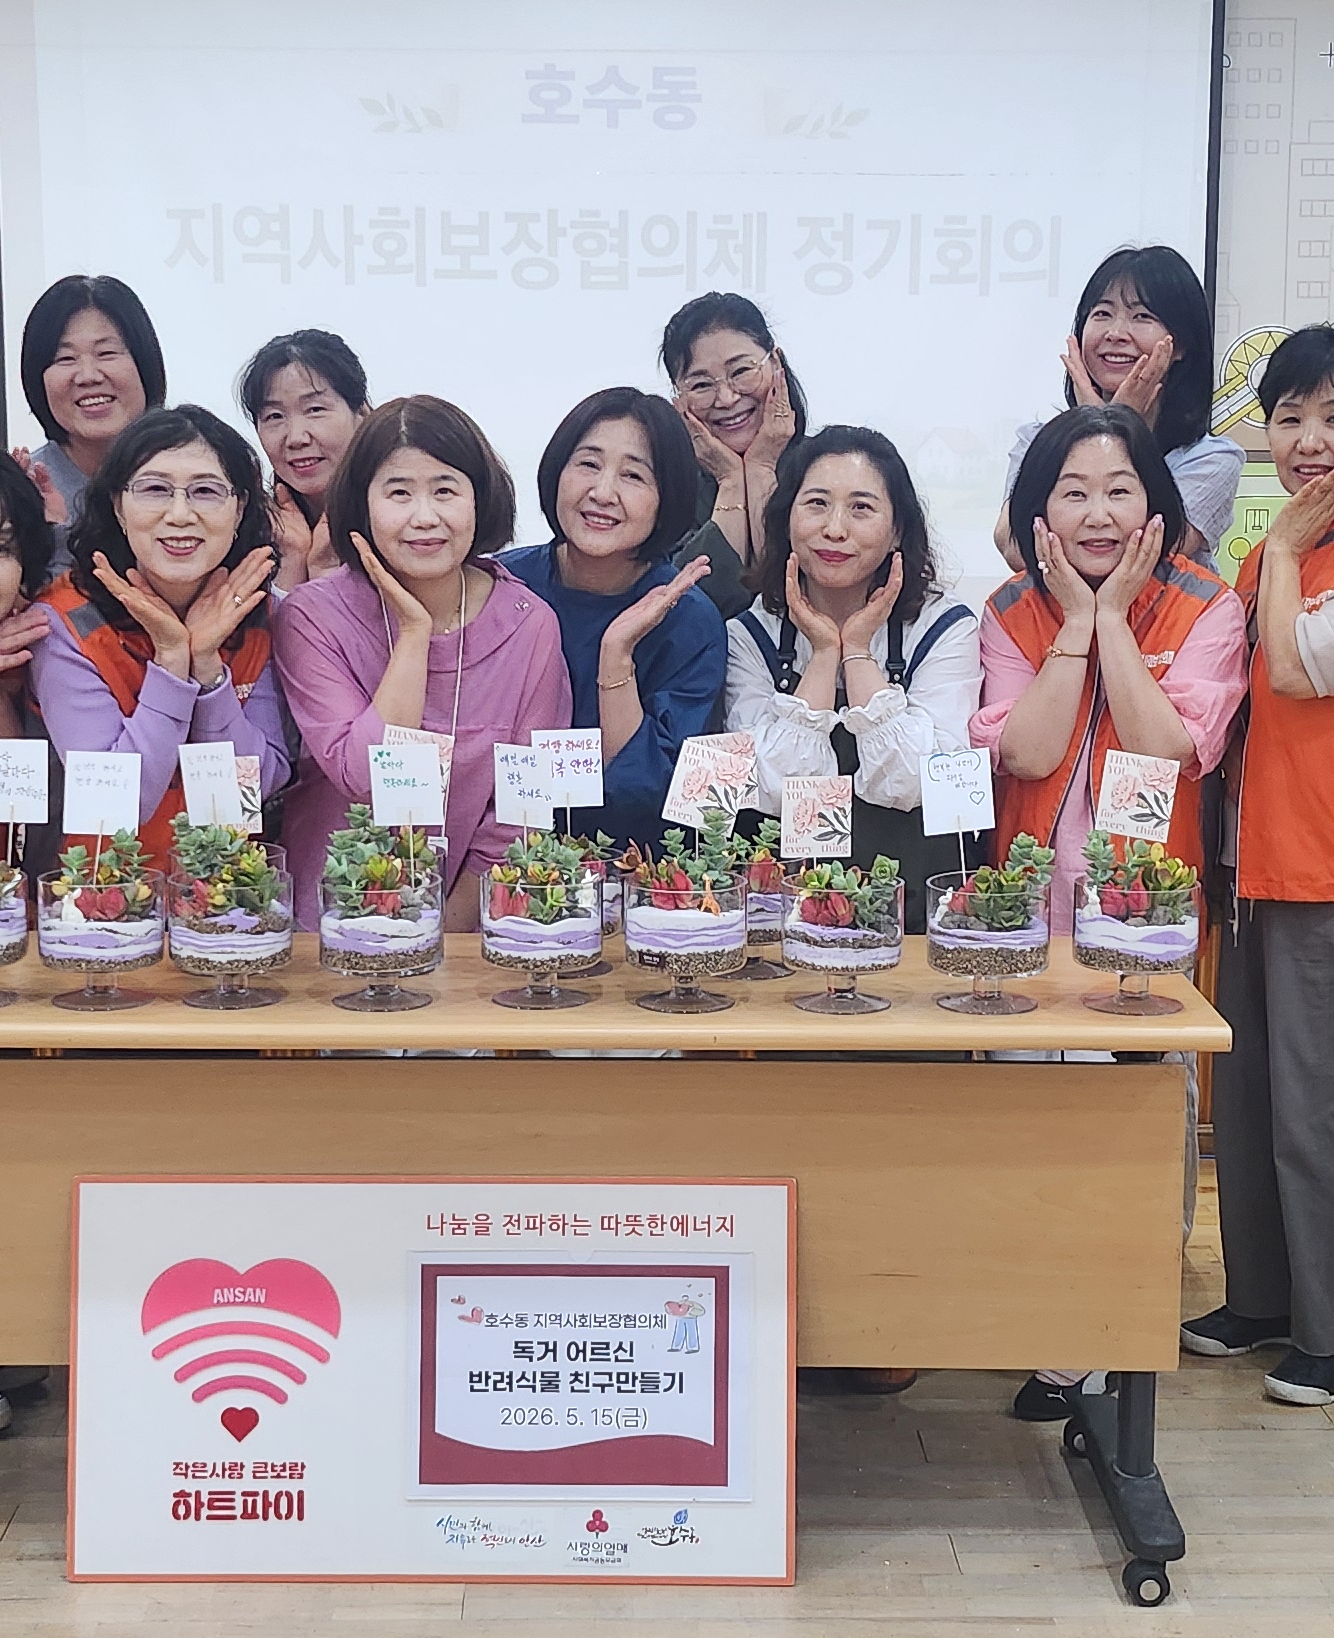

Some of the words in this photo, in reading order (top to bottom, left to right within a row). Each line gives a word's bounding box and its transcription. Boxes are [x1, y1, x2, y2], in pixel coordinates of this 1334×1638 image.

[520, 63, 703, 131] 호수동
[163, 200, 769, 294] 지역사회보장협의체
[793, 208, 1064, 298] 정기회의
[686, 745, 718, 761] THANK
[1109, 754, 1144, 769] THANK
[785, 780, 819, 790] THANK
[785, 834, 801, 844] for
[784, 846, 812, 856] every
[821, 843, 849, 854] thing
[426, 1212, 494, 1237] 나눔을
[501, 1213, 592, 1237] 전파하는
[213, 1287, 266, 1304] ANSAN
[484, 1312, 530, 1329] 호수동
[533, 1312, 667, 1330] 지역사회보장협의체
[512, 1340, 558, 1363] 독거
[566, 1340, 635, 1363] 어르신
[468, 1370, 561, 1394] 반려식물
[568, 1370, 685, 1394] 친구만들기
[500, 1407, 559, 1427] 2026.
[566, 1407, 584, 1427] 5.
[591, 1406, 649, 1430] 15(금)
[172, 1461, 245, 1479] 작은사랑
[252, 1461, 306, 1479] 큰보람
[171, 1489, 305, 1522] 하트파이
